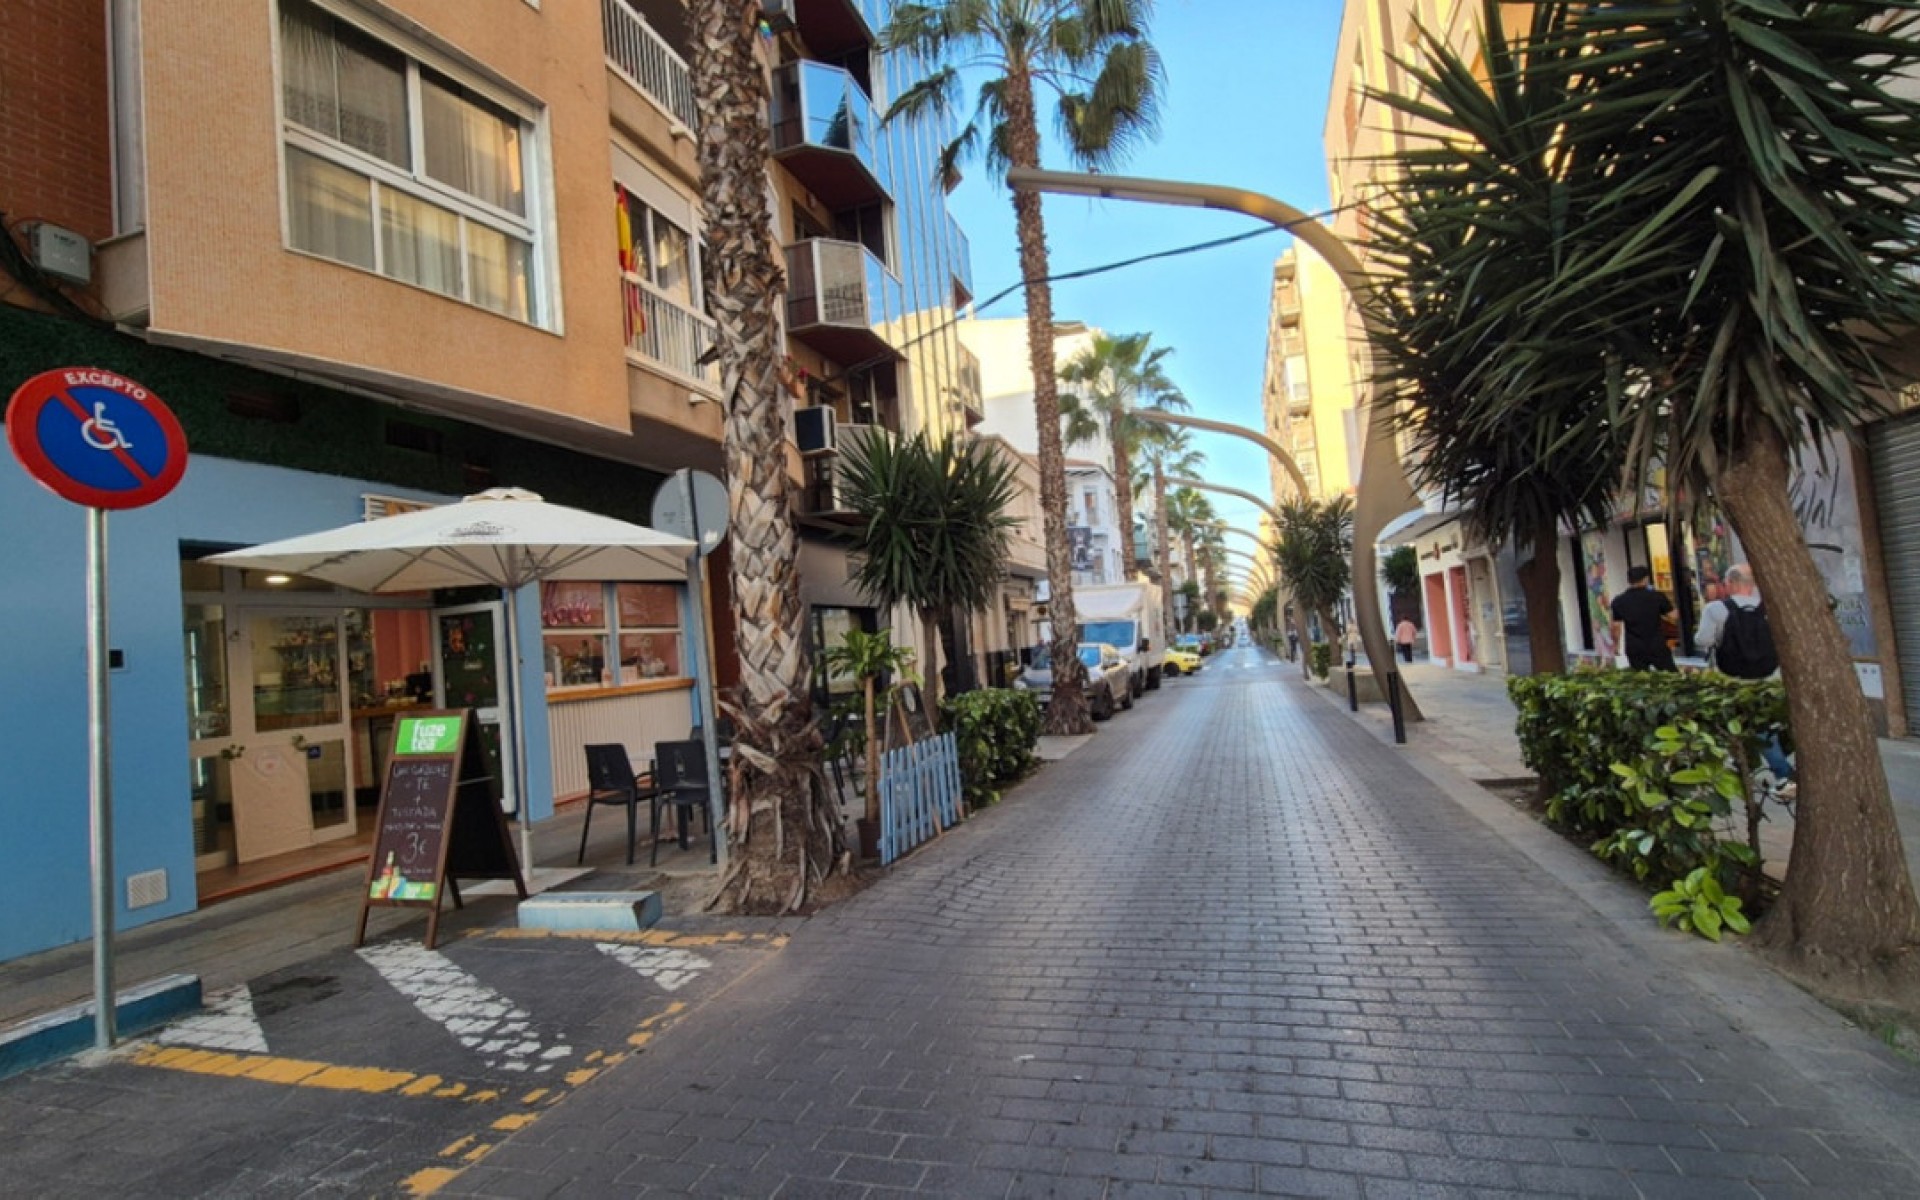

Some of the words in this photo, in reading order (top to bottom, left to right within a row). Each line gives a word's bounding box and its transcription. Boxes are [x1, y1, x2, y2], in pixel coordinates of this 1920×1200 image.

[64, 372, 147, 401] EXCEPTO
[413, 719, 446, 737] fuze
[411, 735, 437, 752] tea
